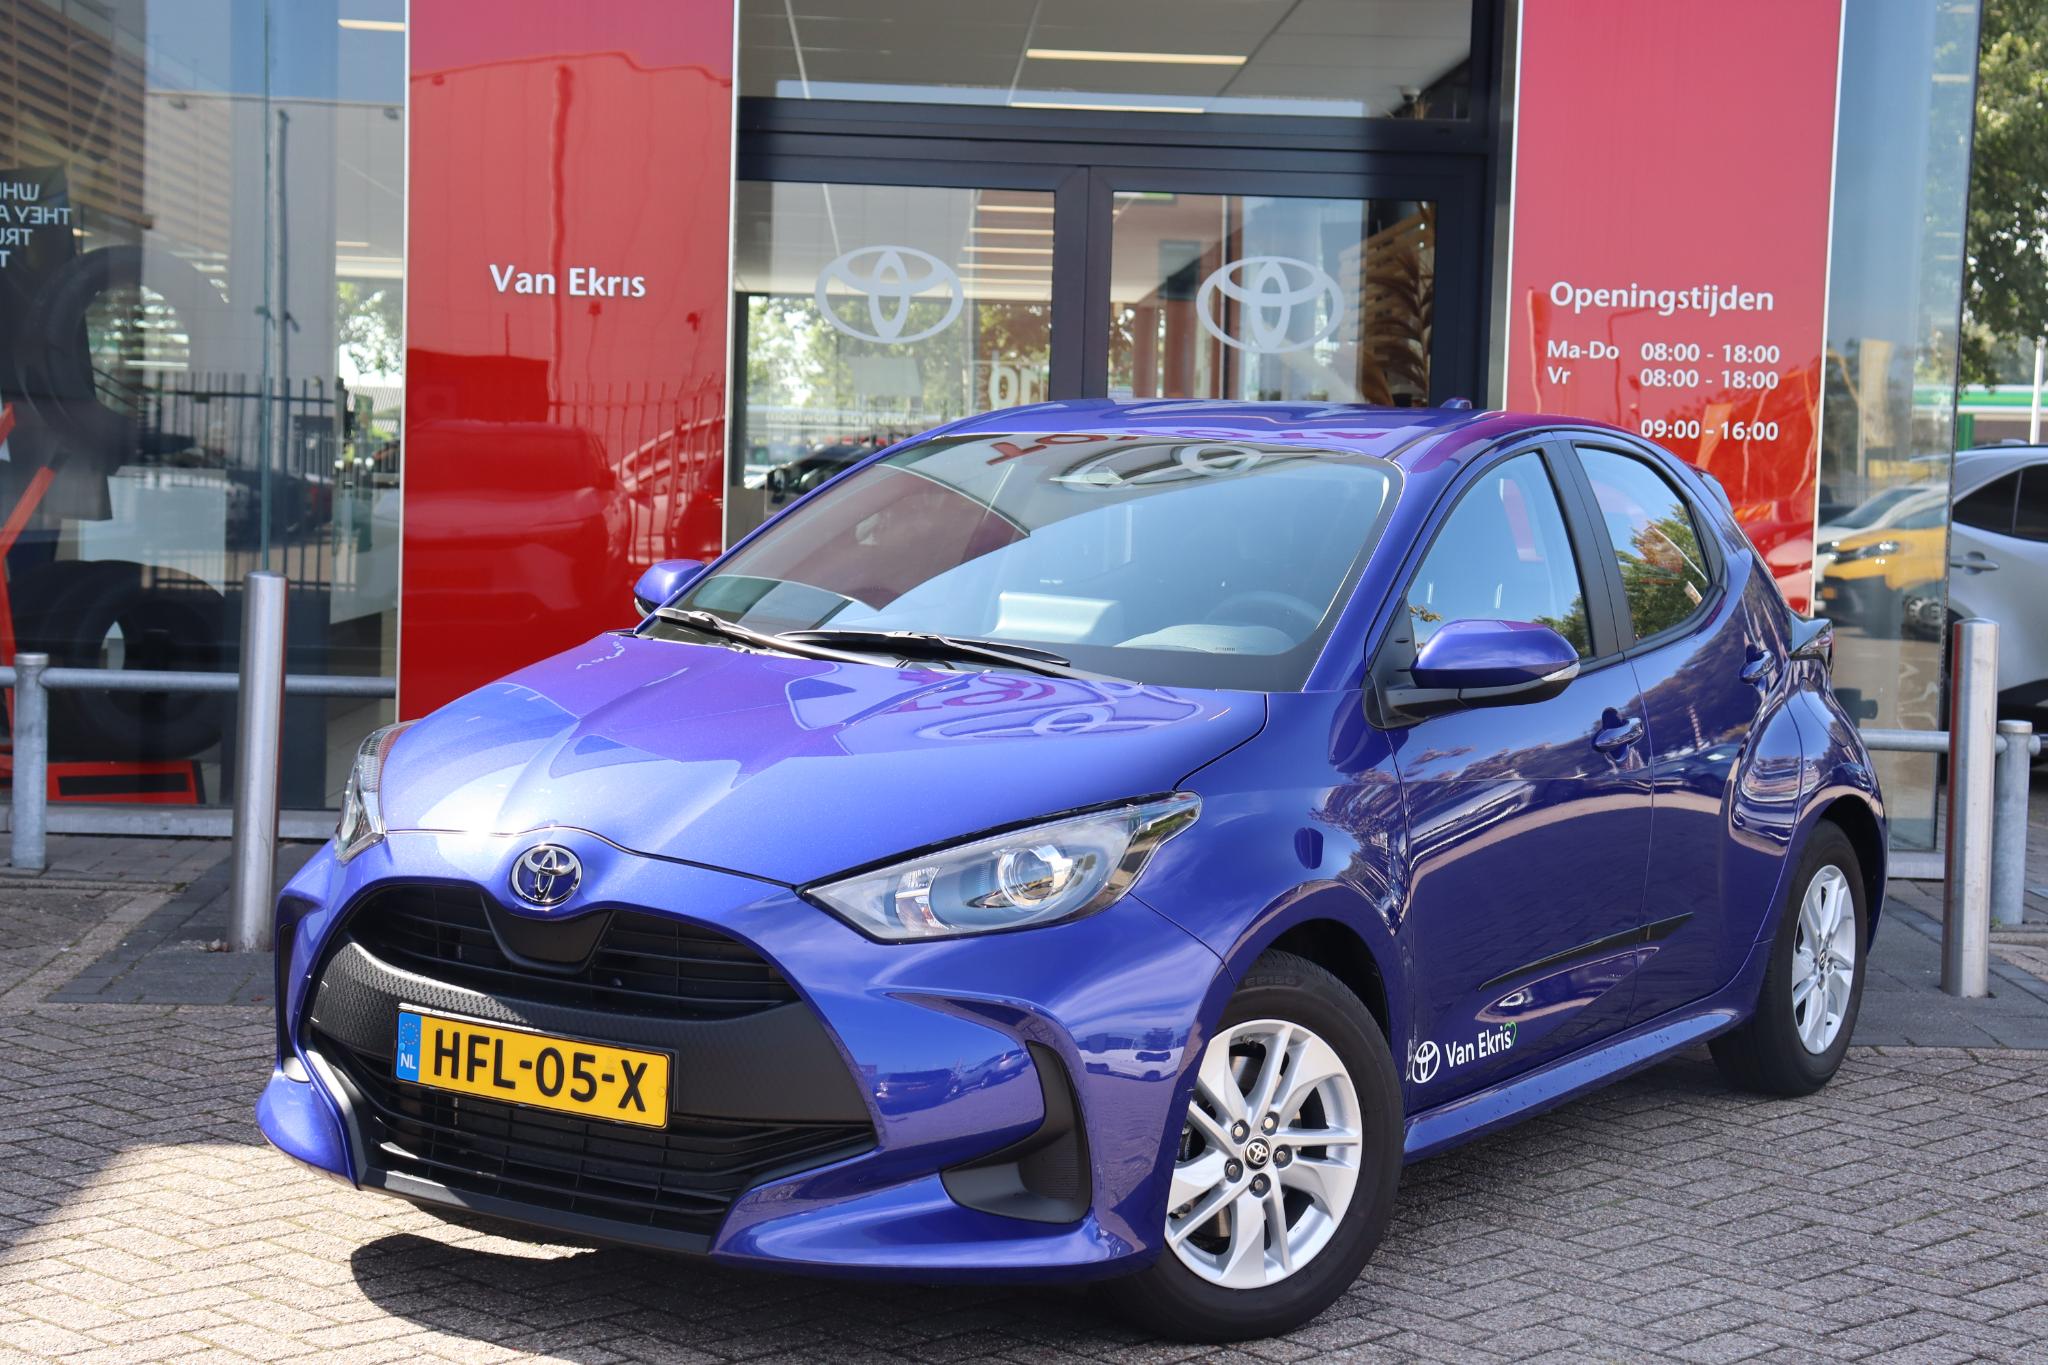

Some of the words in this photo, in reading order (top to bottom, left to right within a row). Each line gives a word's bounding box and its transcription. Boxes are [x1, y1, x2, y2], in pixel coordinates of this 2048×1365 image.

[489, 263, 556, 295] Van
[568, 267, 647, 298] Ekris
[1549, 280, 1775, 317] Openingstijden
[1547, 339, 1620, 360] Ma-Do
[1640, 342, 1700, 362] 08:00
[1722, 344, 1780, 364] 18:00
[1547, 366, 1572, 385] Vr
[1640, 368, 1700, 388] 08:00
[1721, 370, 1779, 390] 18:00
[1640, 419, 1700, 439] 09:00
[1720, 421, 1779, 441] 16:00
[400, 1052, 417, 1071] NL
[1445, 1041, 1475, 1068] Van
[1477, 1025, 1512, 1059] Ekris
[433, 1028, 649, 1113] HFL-05-X
